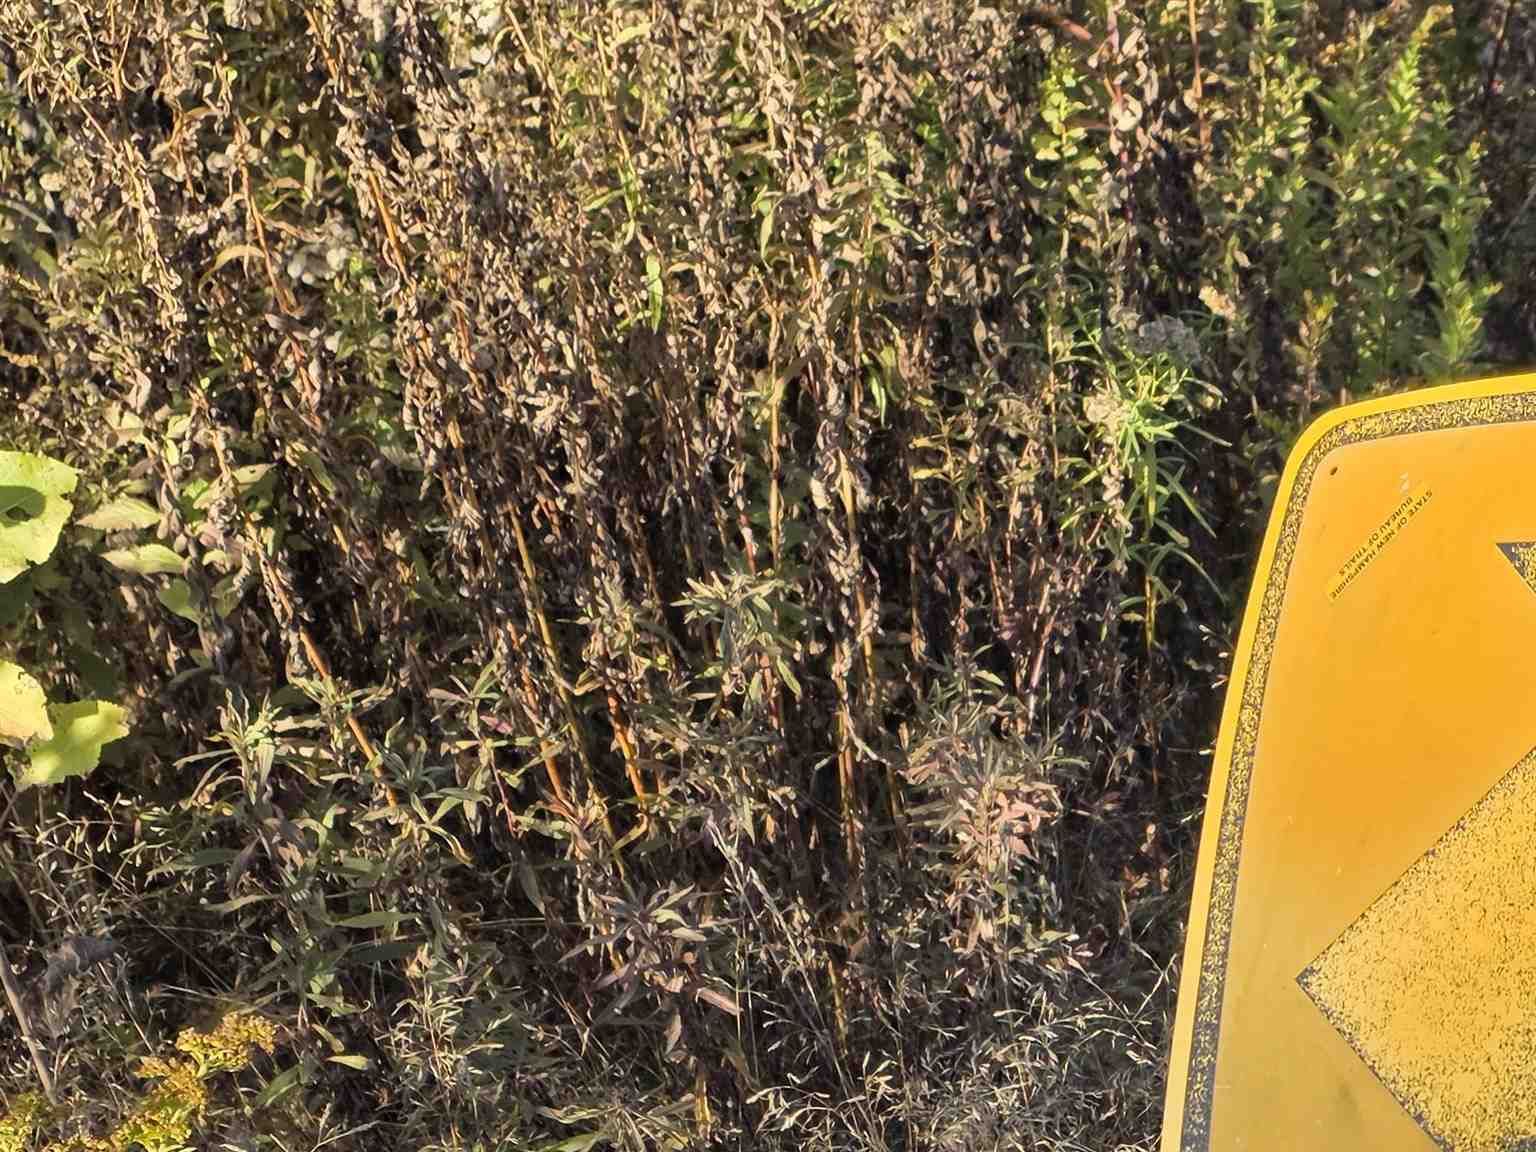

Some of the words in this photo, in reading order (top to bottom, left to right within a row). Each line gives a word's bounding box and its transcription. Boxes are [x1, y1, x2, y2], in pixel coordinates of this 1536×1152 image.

[1379, 496, 1413, 533] BUREAU
[1408, 490, 1432, 517] STATE
[1397, 516, 1408, 530] OF
[1367, 532, 1379, 546] OF
[1376, 529, 1396, 550] NEW
[1331, 549, 1376, 599] HAMPSHIRE
[1339, 547, 1367, 575] TRAILS
